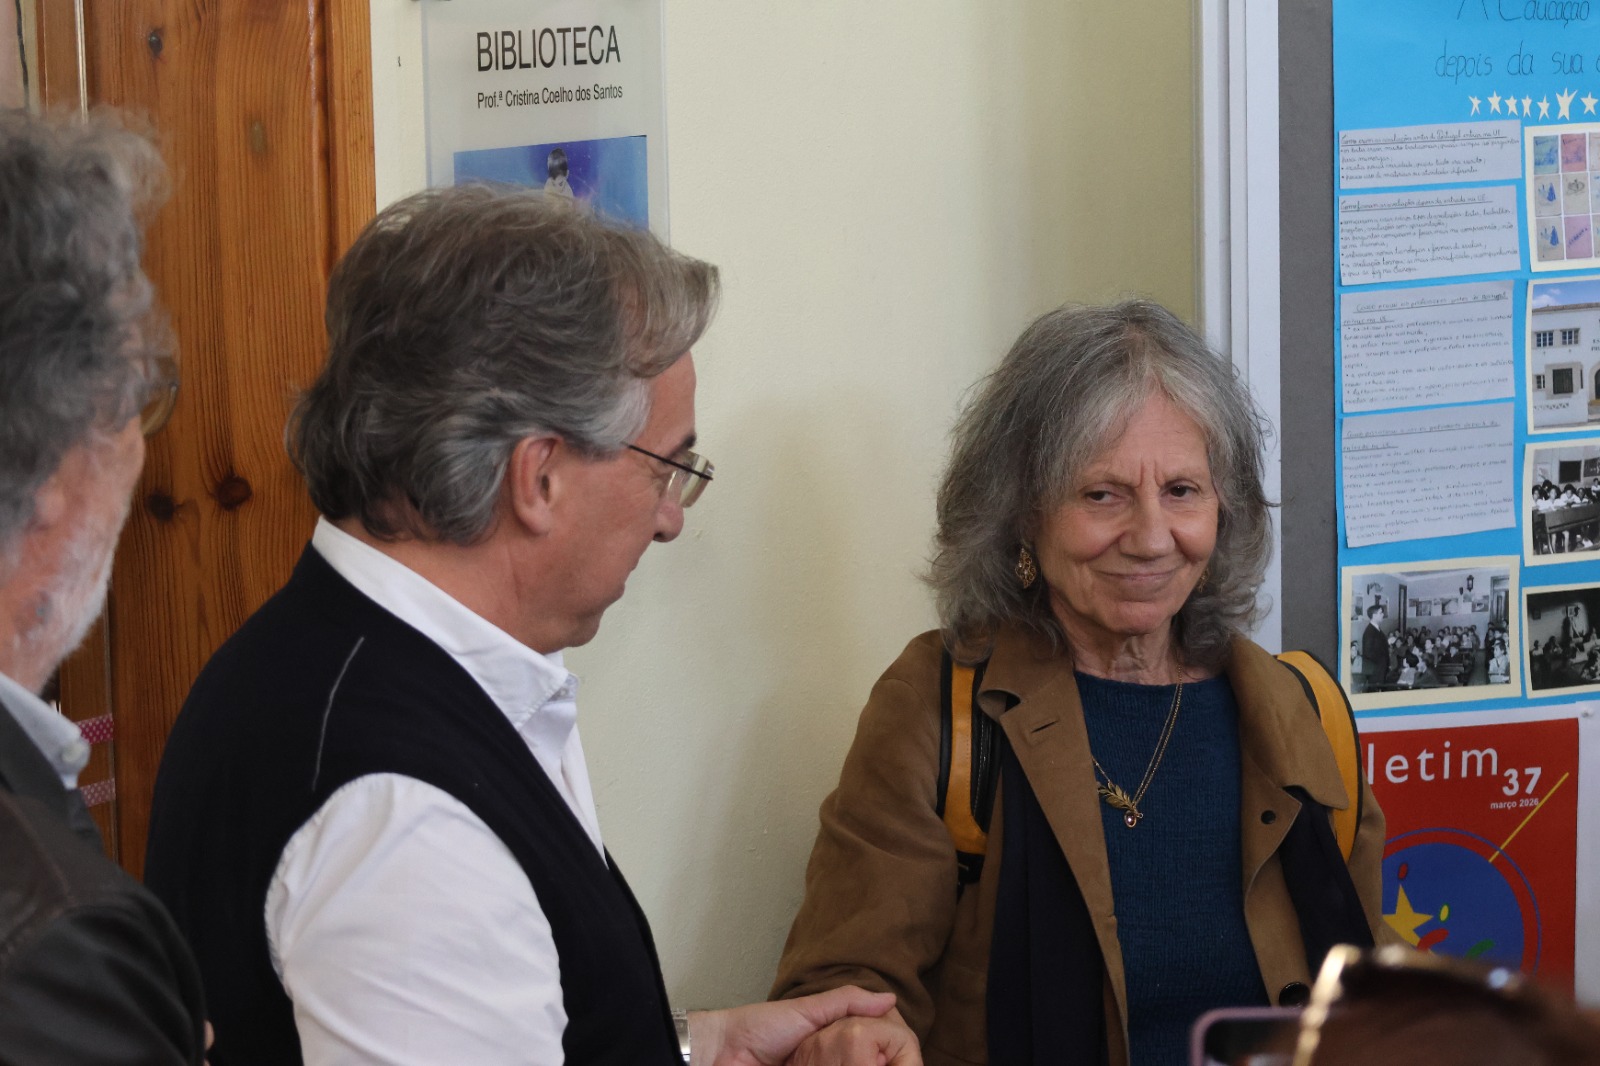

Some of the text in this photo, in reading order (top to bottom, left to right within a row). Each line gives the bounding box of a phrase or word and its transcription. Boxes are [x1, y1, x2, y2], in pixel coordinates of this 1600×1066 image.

[476, 25, 621, 72] BIBLIOTECA
[1435, 39, 1493, 85] depois
[1506, 39, 1534, 76] da
[1551, 50, 1584, 75] sua
[477, 84, 623, 109] Prof.ª Cristina Coelho dos Santos
[1367, 741, 1498, 785] letim
[1502, 767, 1542, 797] 37
[1490, 797, 1540, 811] março 2026
